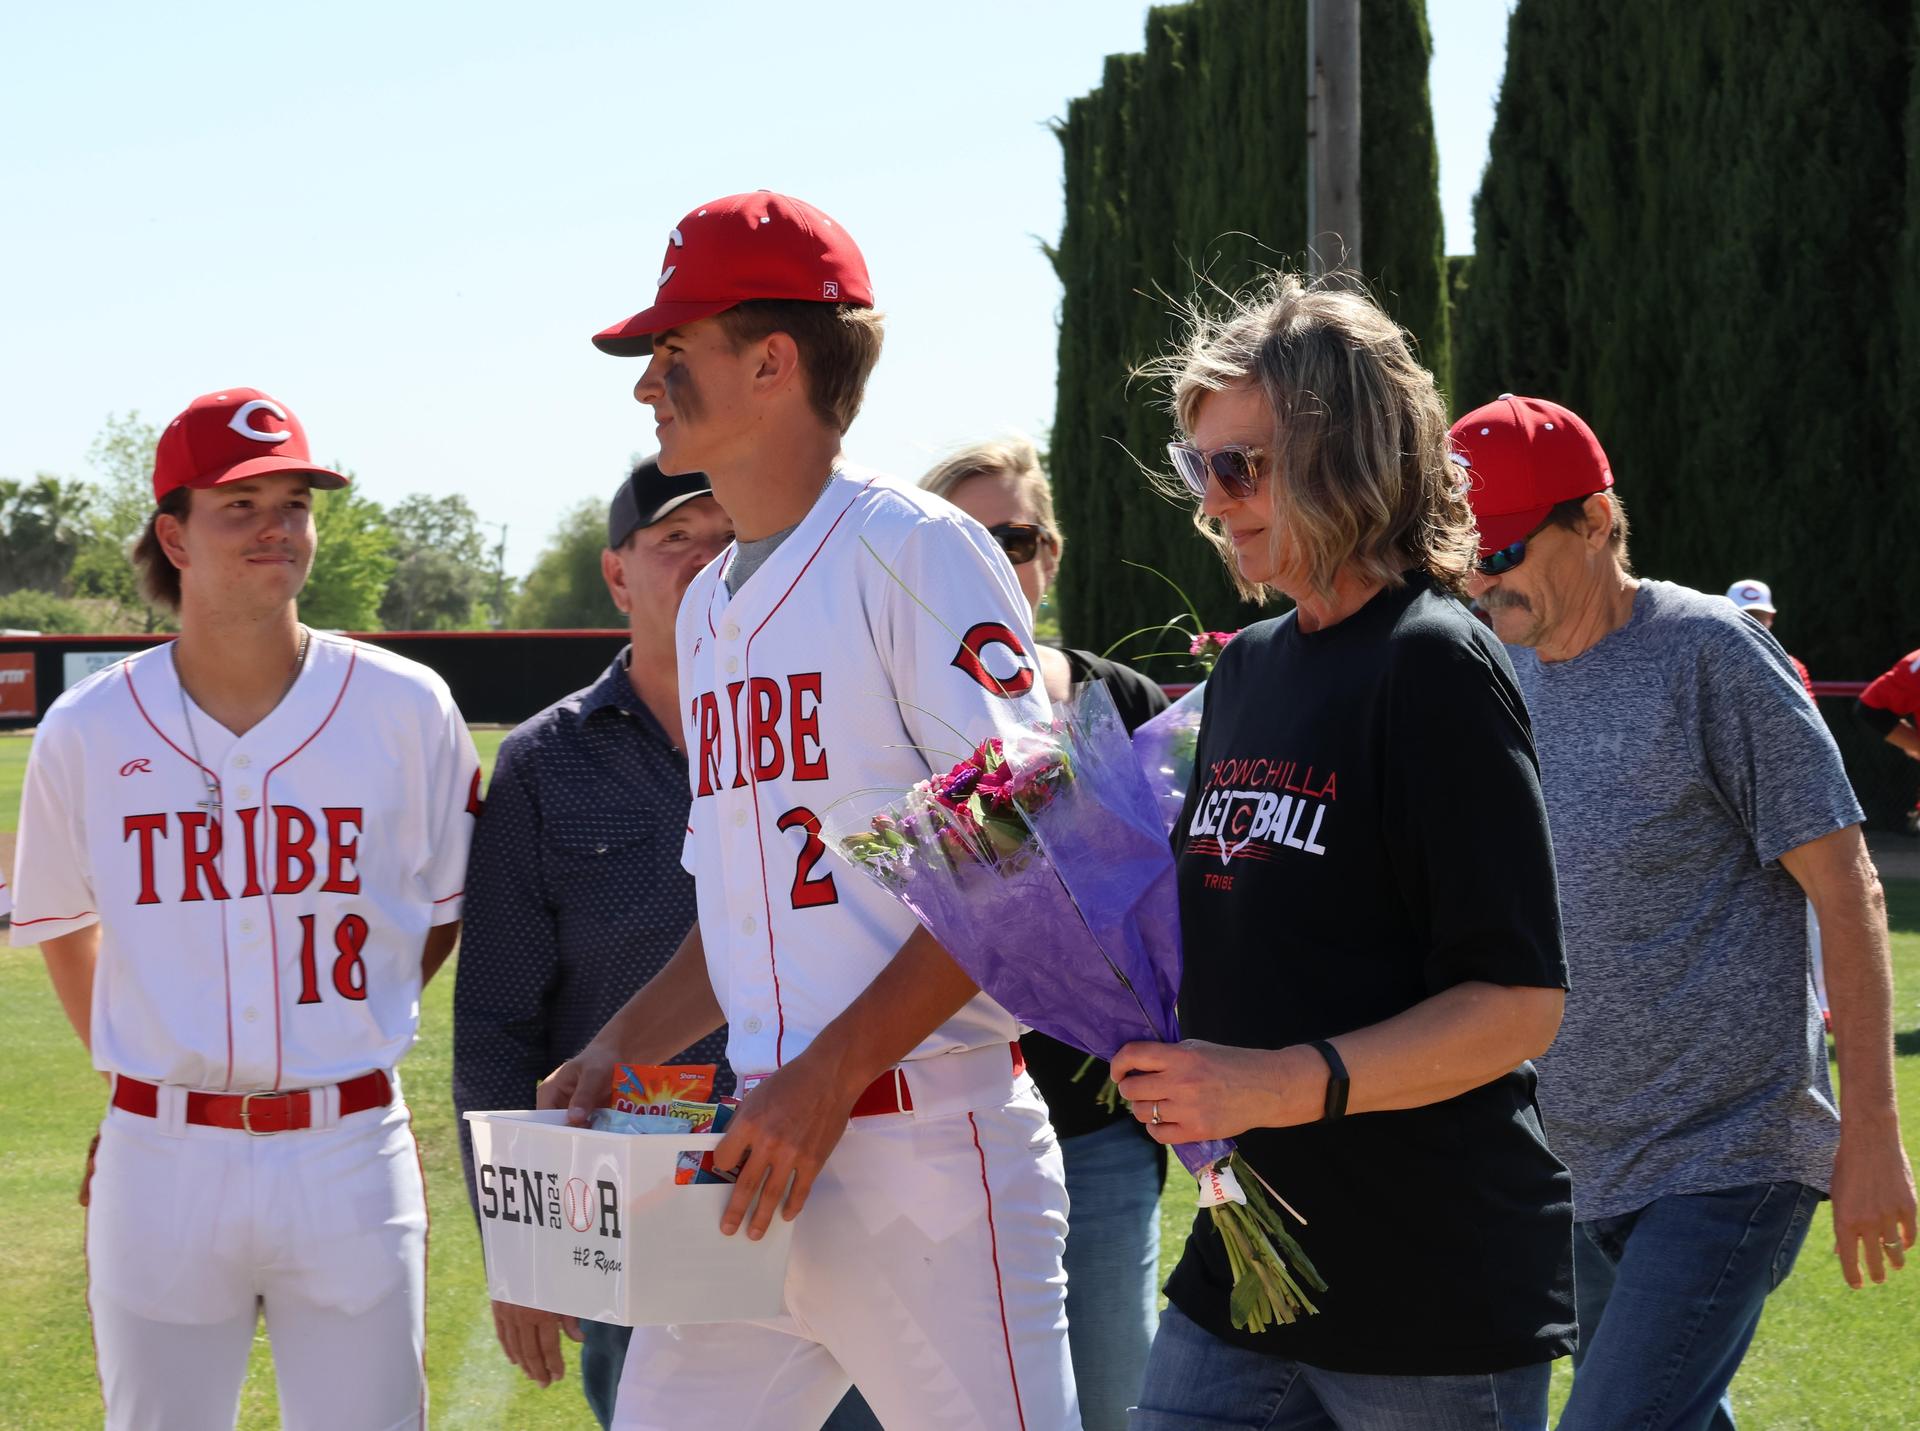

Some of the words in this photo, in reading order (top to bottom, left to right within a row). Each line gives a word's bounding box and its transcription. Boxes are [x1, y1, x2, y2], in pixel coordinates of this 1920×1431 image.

[227, 399, 292, 444] C
[950, 621, 1035, 700] C
[1205, 758, 1338, 801] HOWCHILLA
[124, 805, 364, 905] TRIBE
[777, 805, 839, 910] 2
[1203, 873, 1236, 891] TRIBE
[297, 913, 370, 1005] 18
[548, 1172, 562, 1231] 2024
[573, 1246, 591, 1268] #2
[593, 1250, 623, 1275] Ryan
